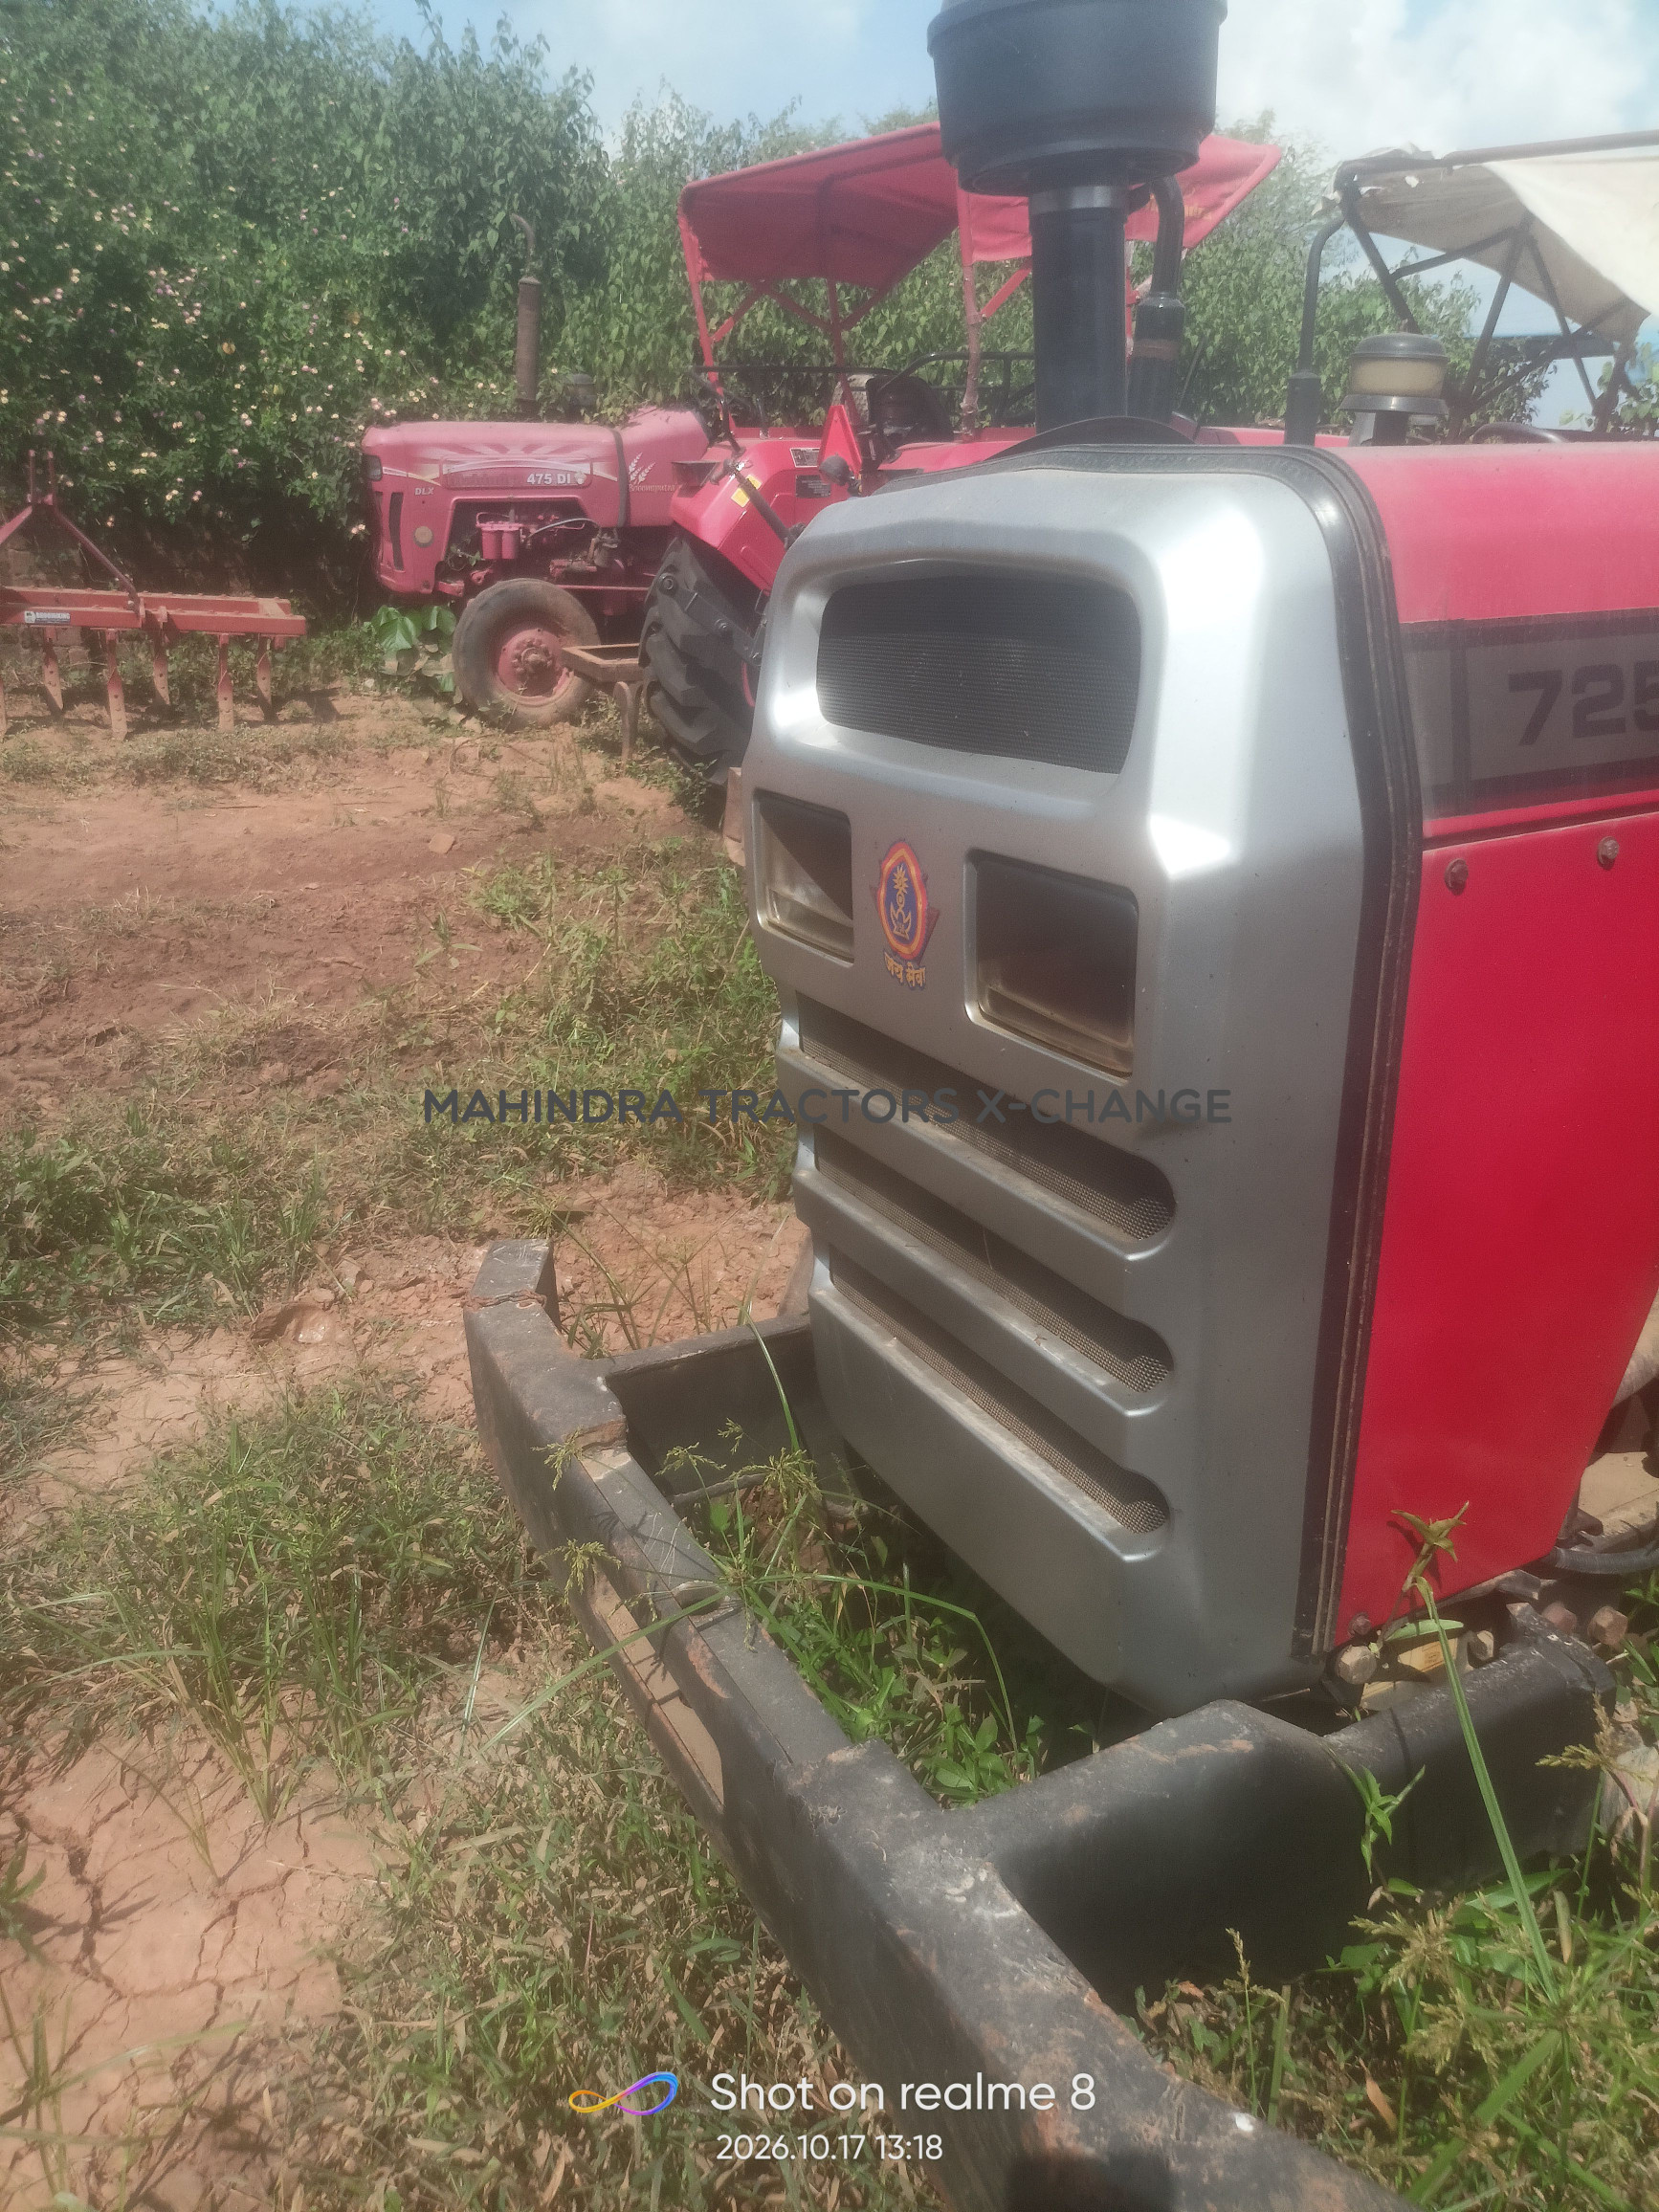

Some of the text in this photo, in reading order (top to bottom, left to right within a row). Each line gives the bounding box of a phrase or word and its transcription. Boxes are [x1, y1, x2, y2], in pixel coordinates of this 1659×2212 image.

[526, 473, 552, 485] 475
[557, 473, 571, 484] DI
[414, 487, 434, 496] DLX
